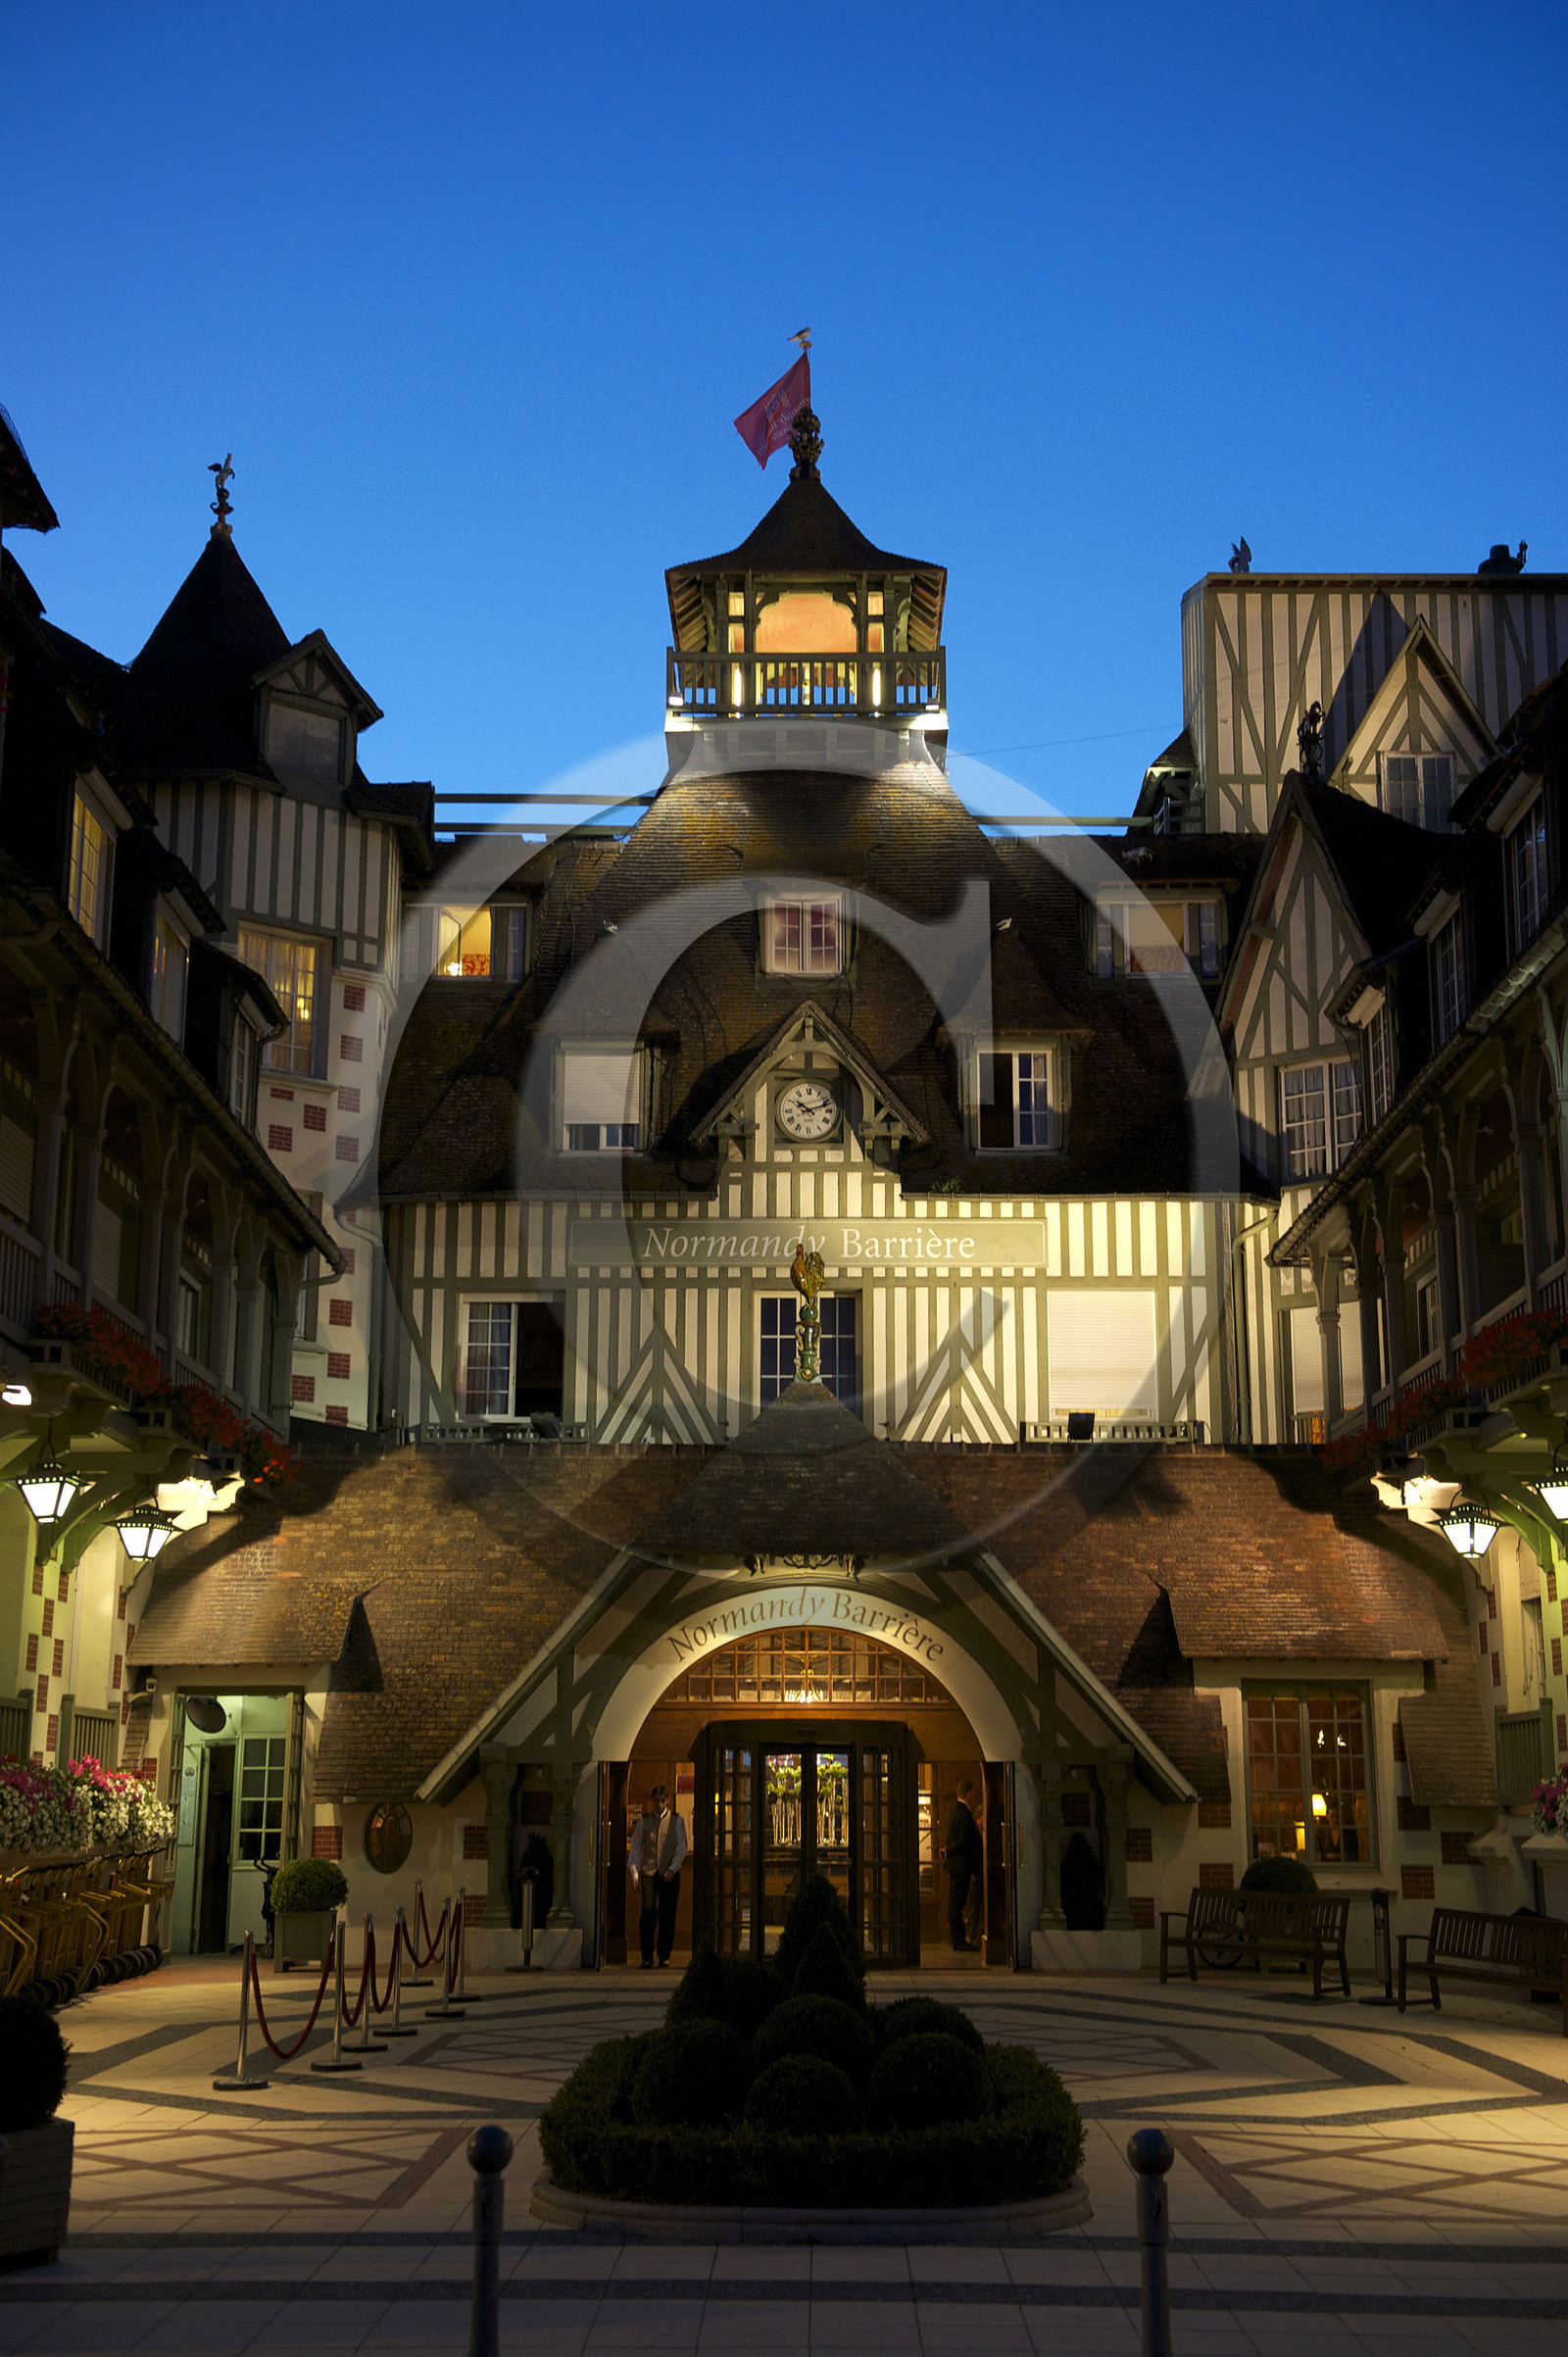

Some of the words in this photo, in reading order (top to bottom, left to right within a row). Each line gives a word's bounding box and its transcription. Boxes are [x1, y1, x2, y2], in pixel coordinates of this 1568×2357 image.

[840, 1227, 975, 1258] Barrière
[666, 1586, 825, 1663] Normandy
[832, 1592, 945, 1661] Barrière
